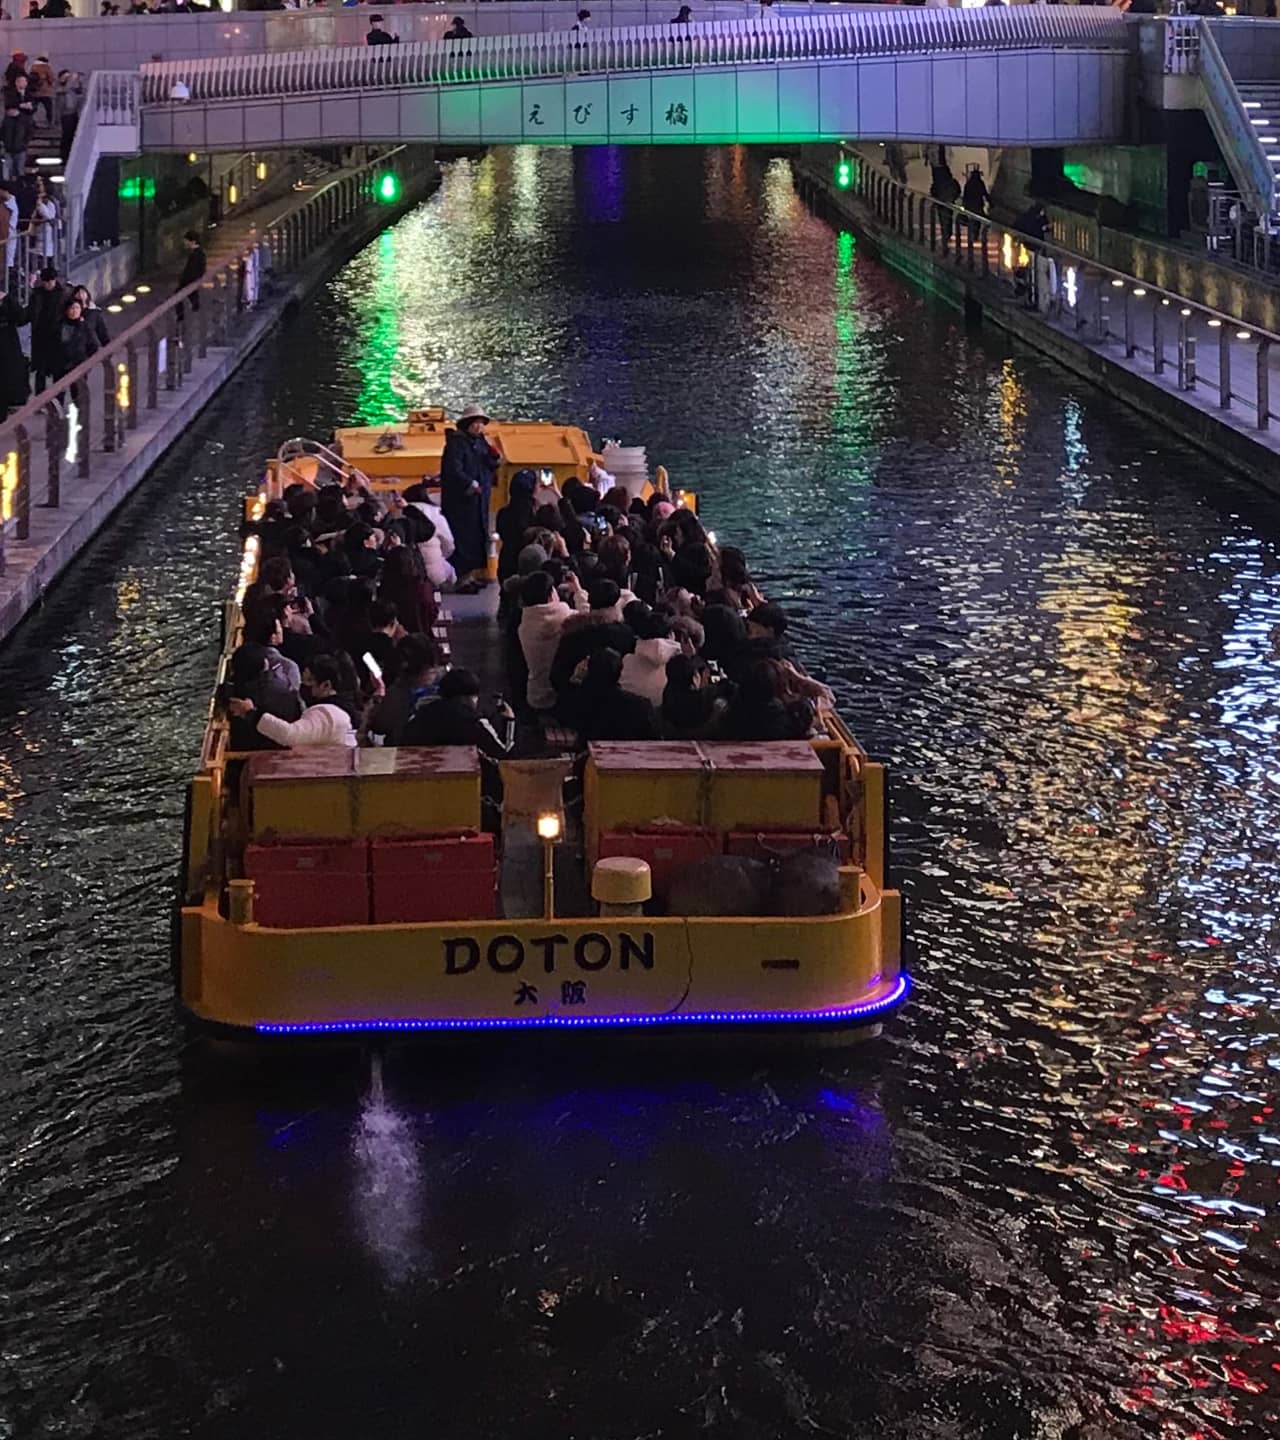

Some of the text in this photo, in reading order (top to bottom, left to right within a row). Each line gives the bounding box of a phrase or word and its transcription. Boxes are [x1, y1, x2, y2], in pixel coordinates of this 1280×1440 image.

[528, 103, 689, 126] えびす橋
[443, 932, 654, 975] DOTON
[514, 981, 587, 1006] 大阪
